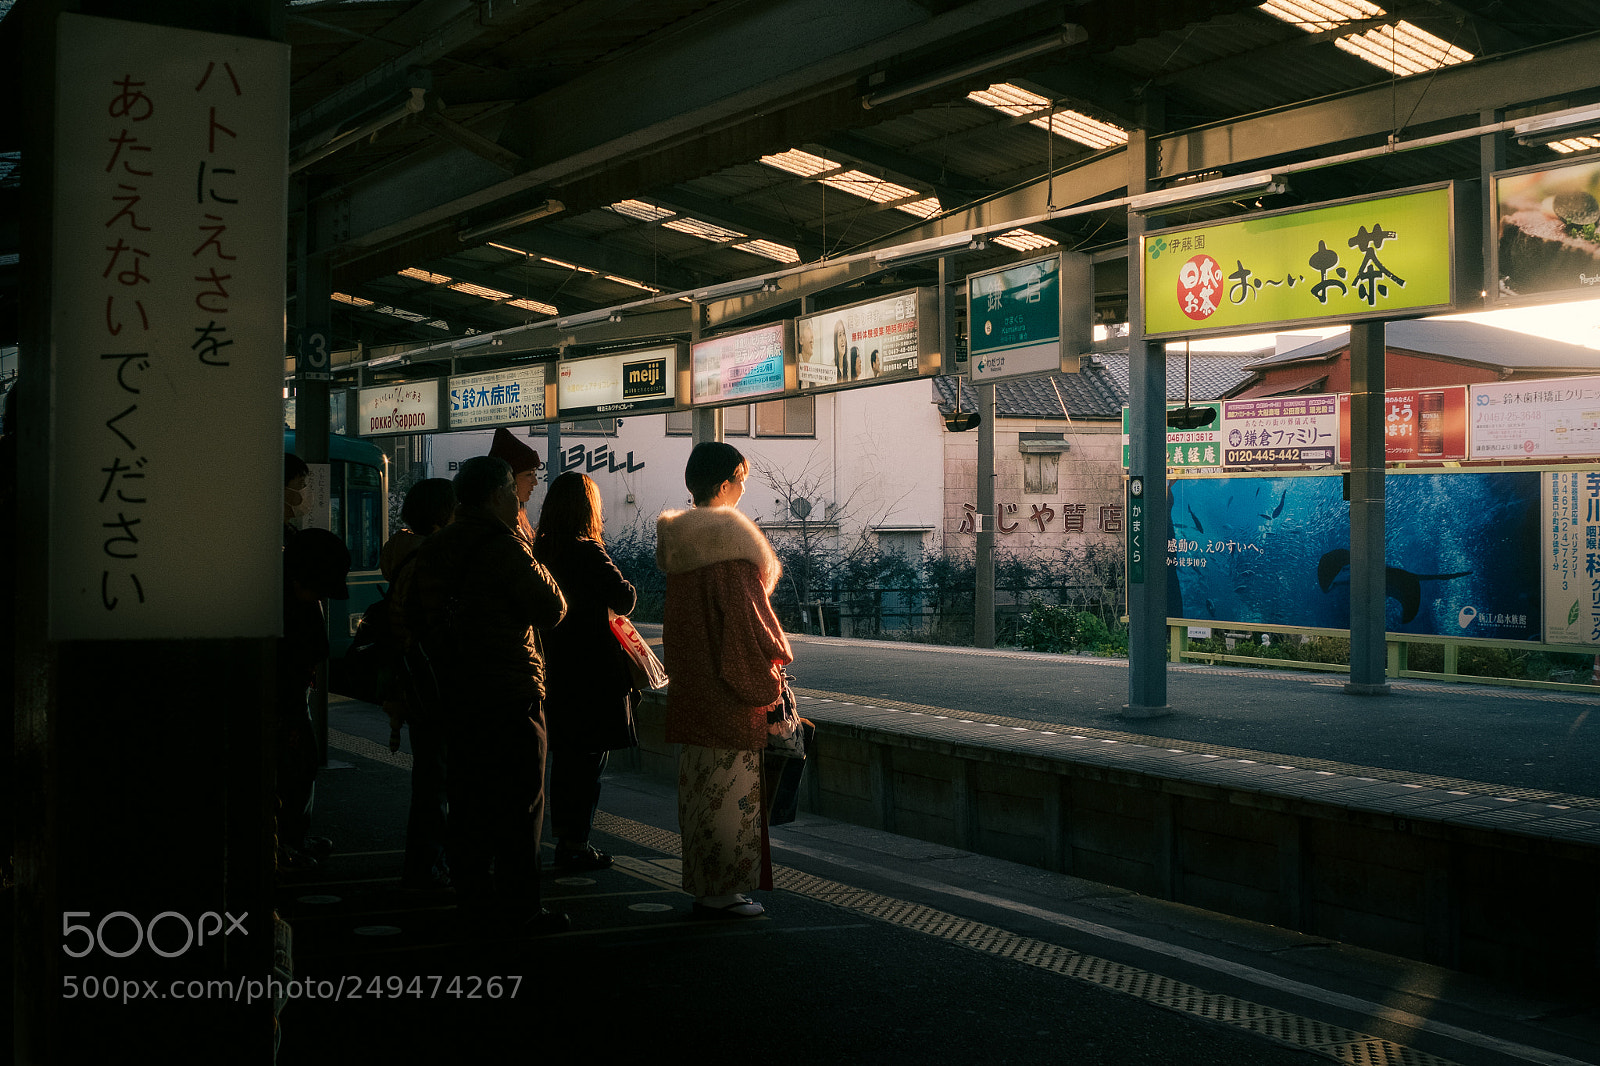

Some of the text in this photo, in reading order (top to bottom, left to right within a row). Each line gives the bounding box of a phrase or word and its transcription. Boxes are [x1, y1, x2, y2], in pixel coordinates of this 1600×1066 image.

[192, 61, 242, 366] ハトにえさを
[1168, 234, 1205, 253] 伊藤園
[98, 74, 154, 611] あたえないでください
[629, 362, 660, 386] meiji
[462, 381, 520, 410] 鈴木病院
[1243, 427, 1332, 447] 鎌倉ファミリー
[560, 443, 646, 474] BELL
[1173, 445, 1217, 465] 義経庵
[1228, 448, 1300, 462] 0120-445-442
[959, 502, 1123, 534] ふじや質店
[1561, 473, 1570, 590] 0467(24)7273
[1132, 504, 1142, 564] かまくら
